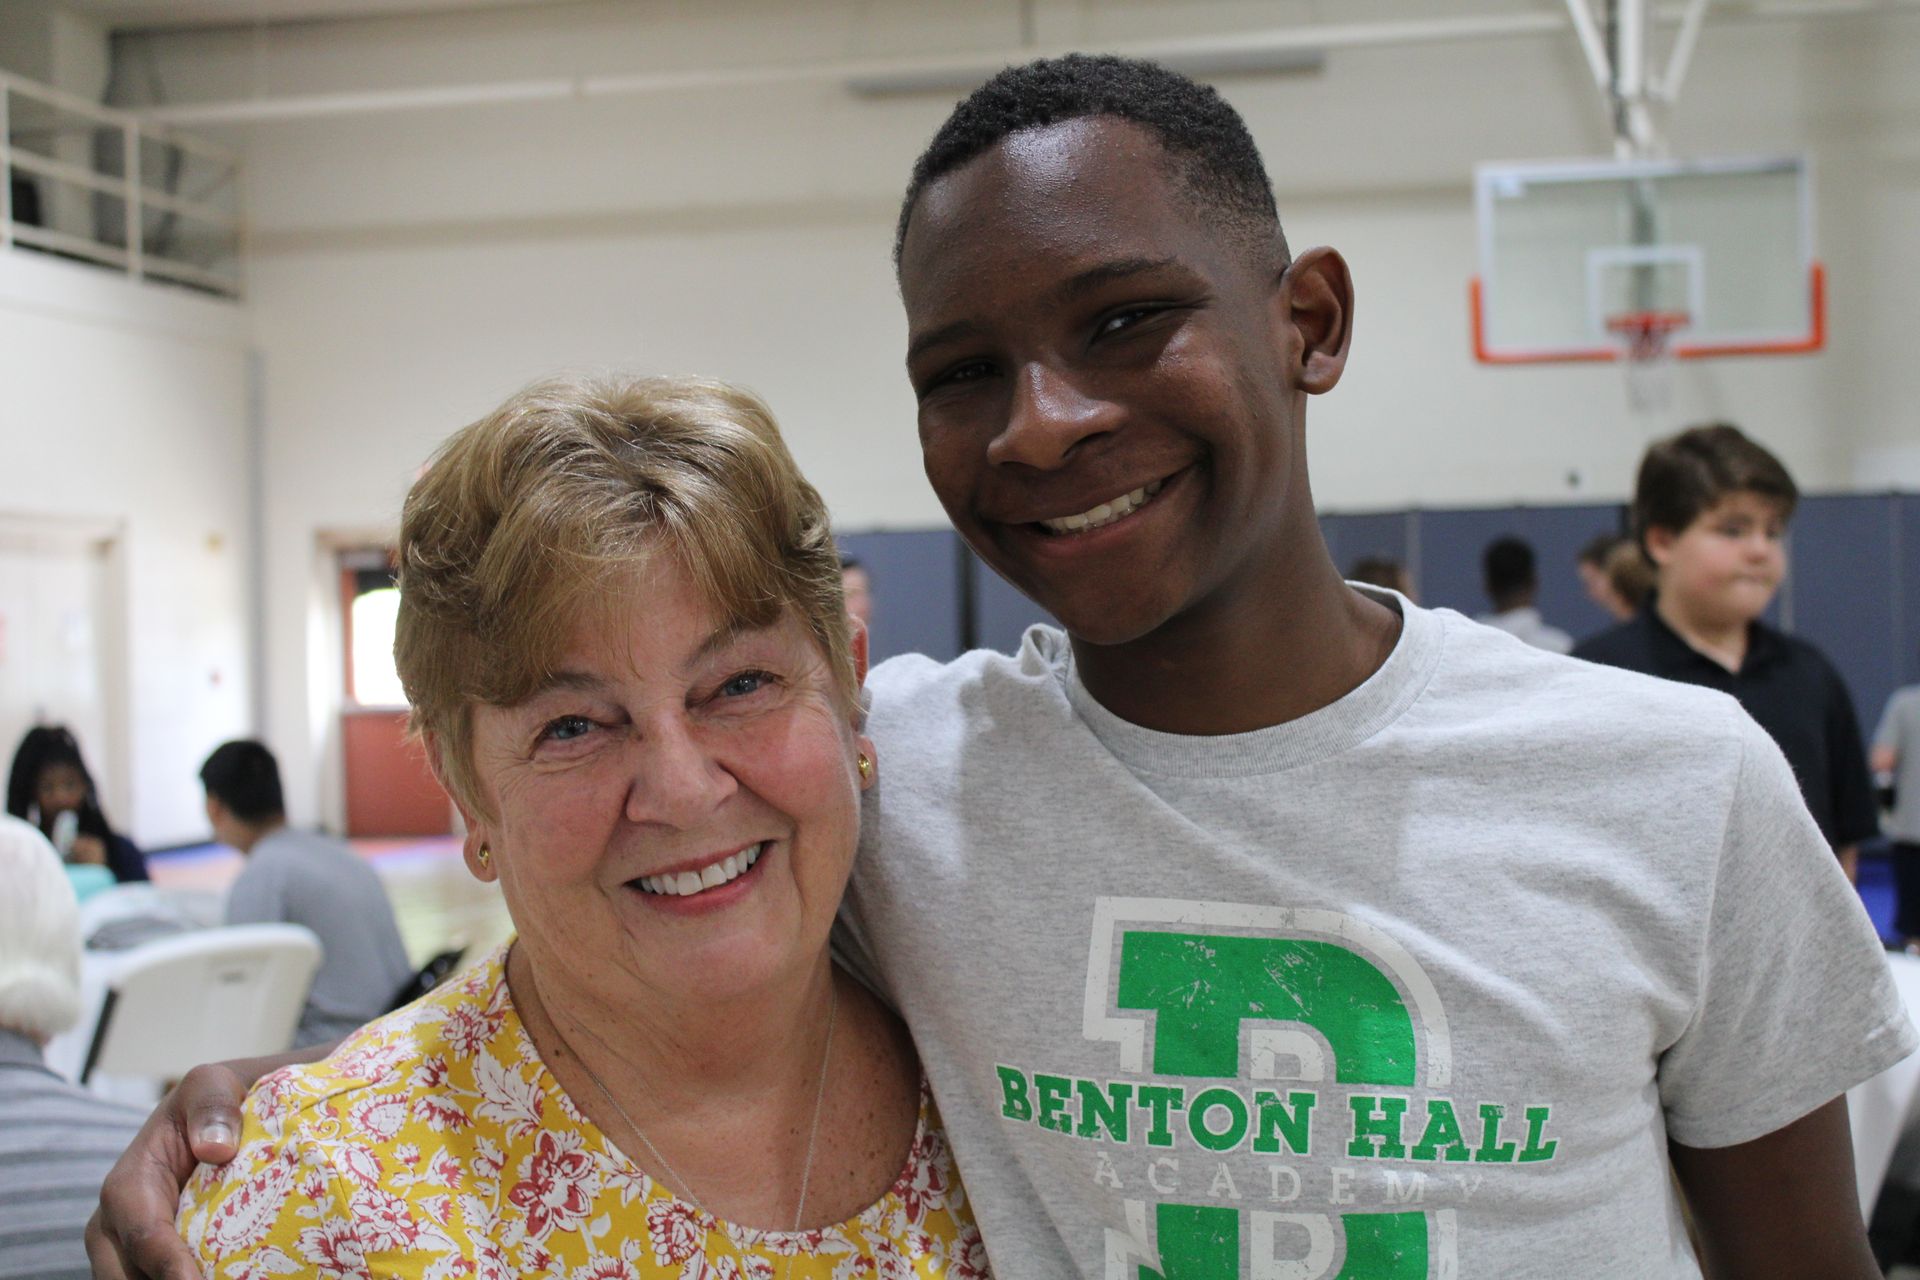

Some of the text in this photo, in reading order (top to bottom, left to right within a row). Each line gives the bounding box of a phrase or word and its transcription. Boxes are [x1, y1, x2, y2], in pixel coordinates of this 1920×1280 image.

[995, 1063, 1562, 1163] BENTON HALL
[1093, 1151, 1486, 1205] ACADEMY
